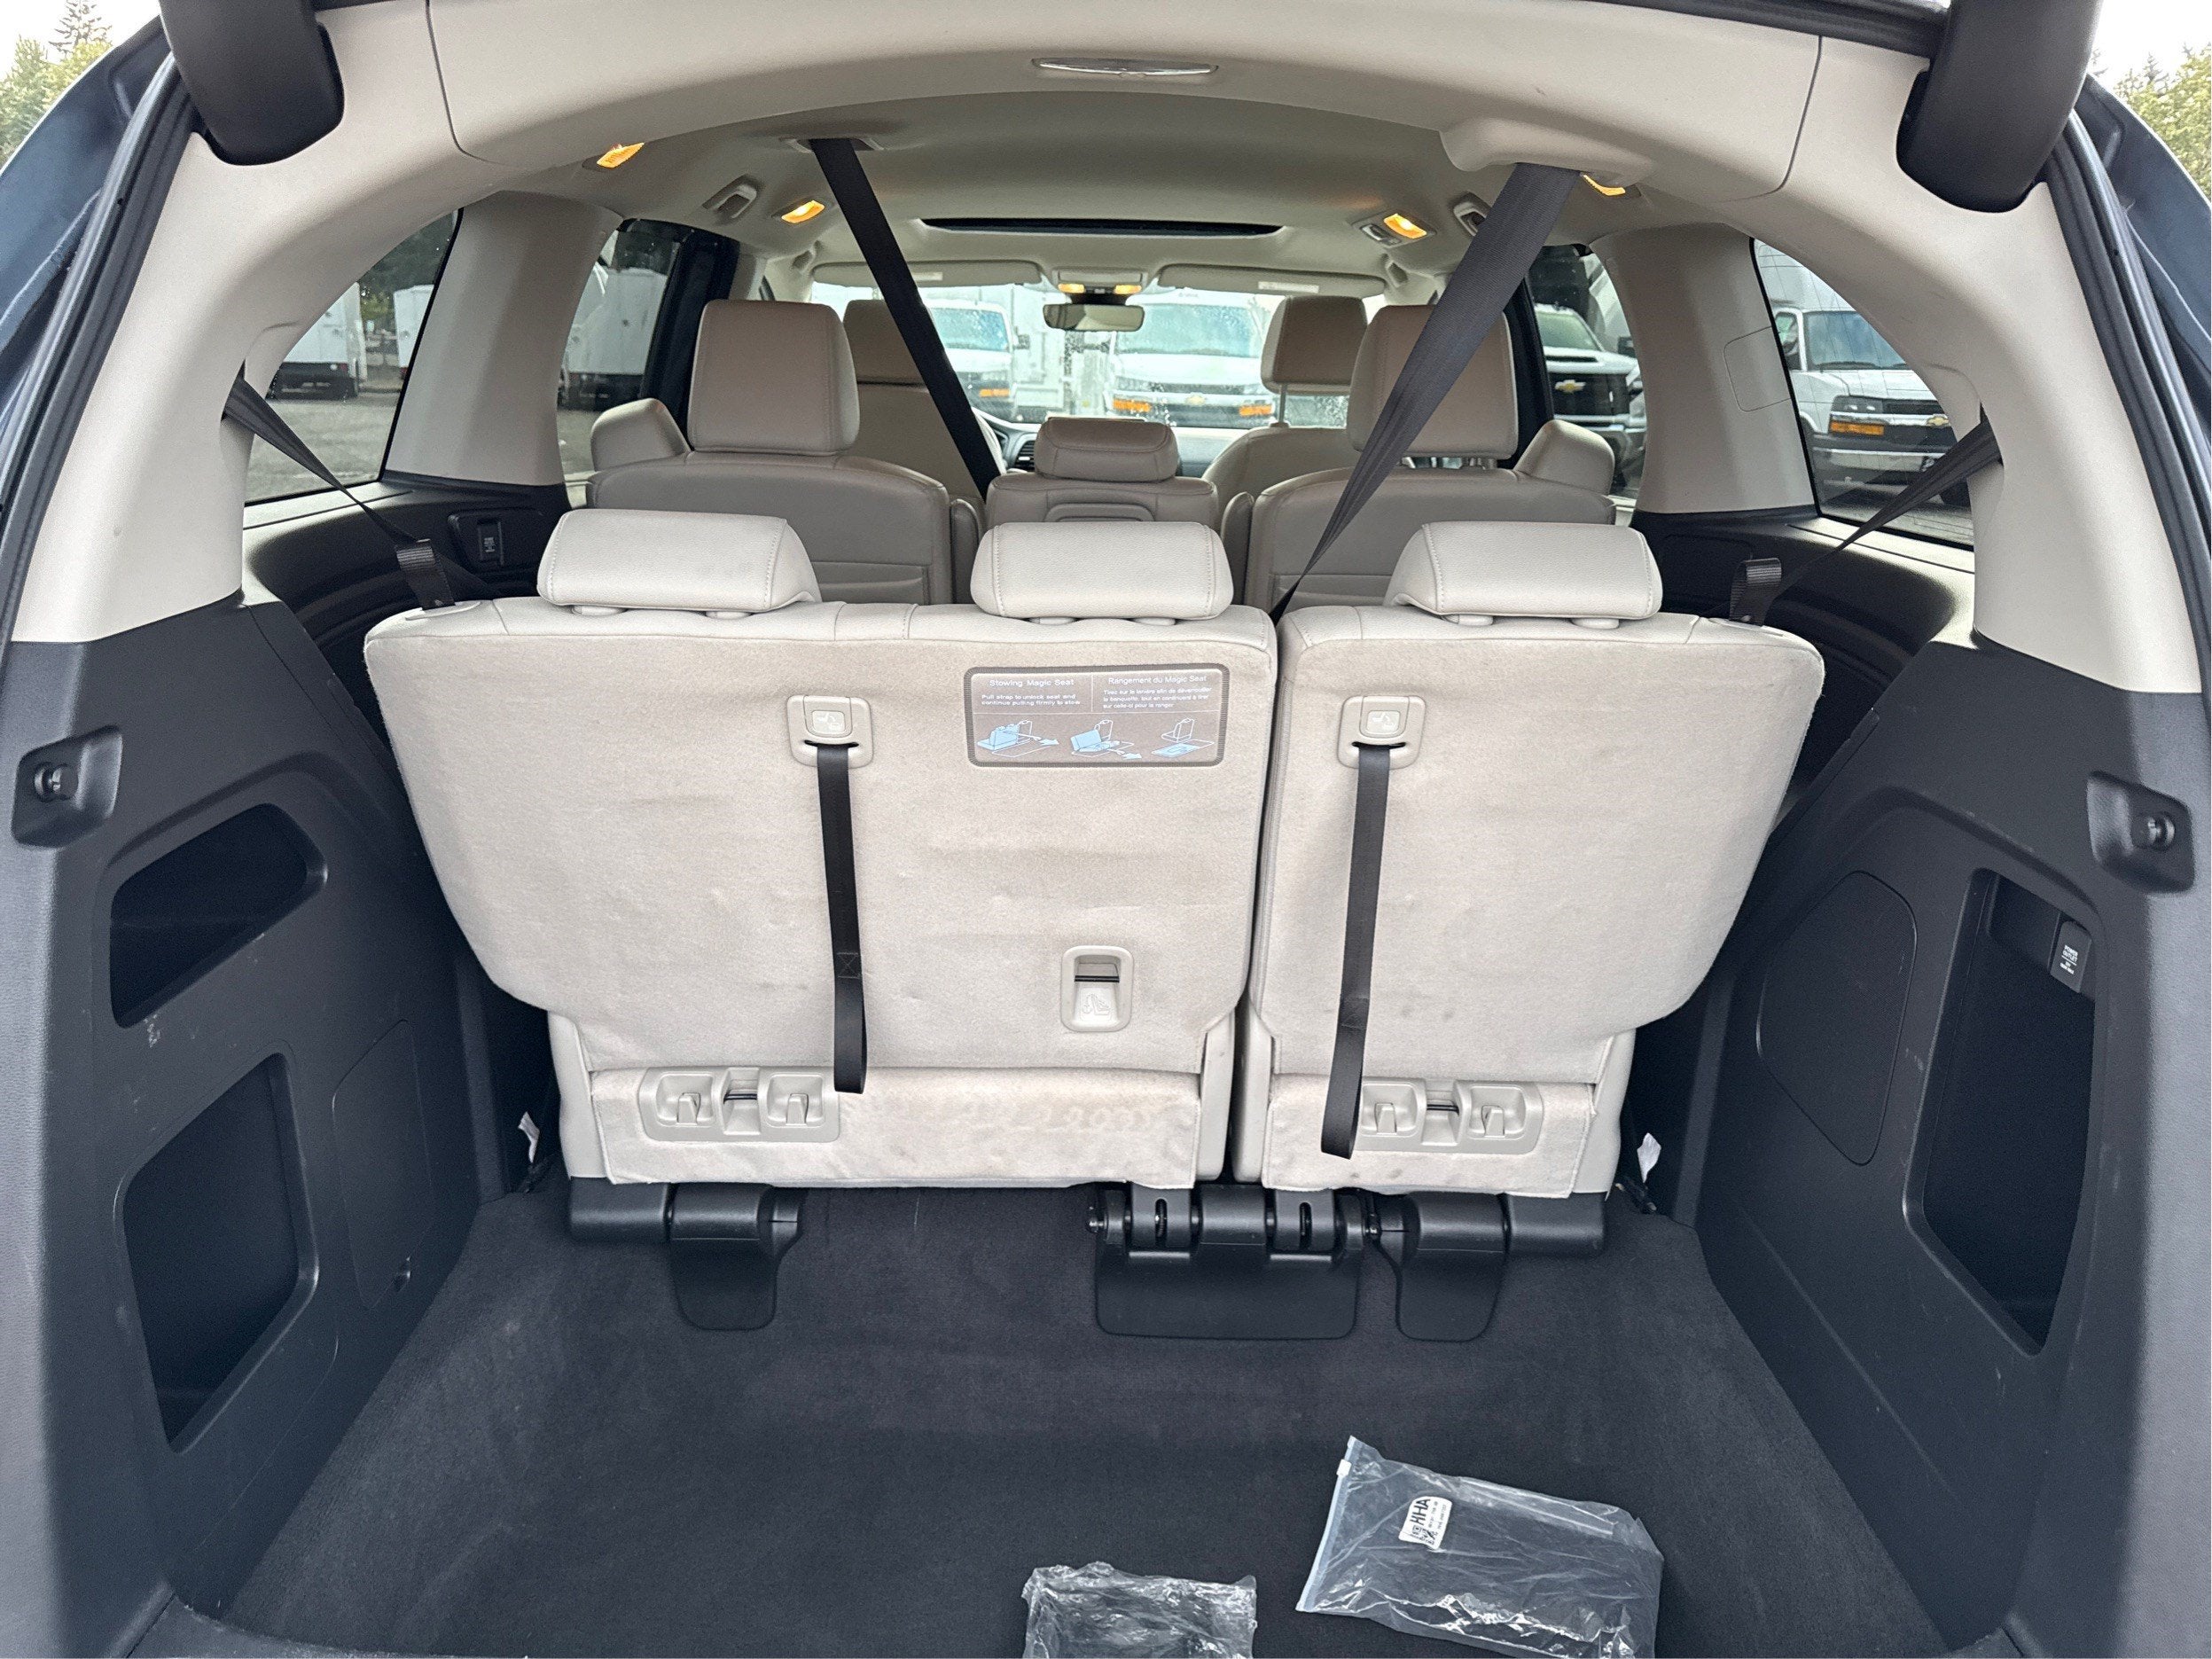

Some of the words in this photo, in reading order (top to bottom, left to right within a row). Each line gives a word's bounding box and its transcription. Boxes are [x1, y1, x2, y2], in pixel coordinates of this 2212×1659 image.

[989, 679, 1023, 688] Stowing
[1108, 677, 1152, 685] Rangement
[1165, 676, 1187, 685] Magic
